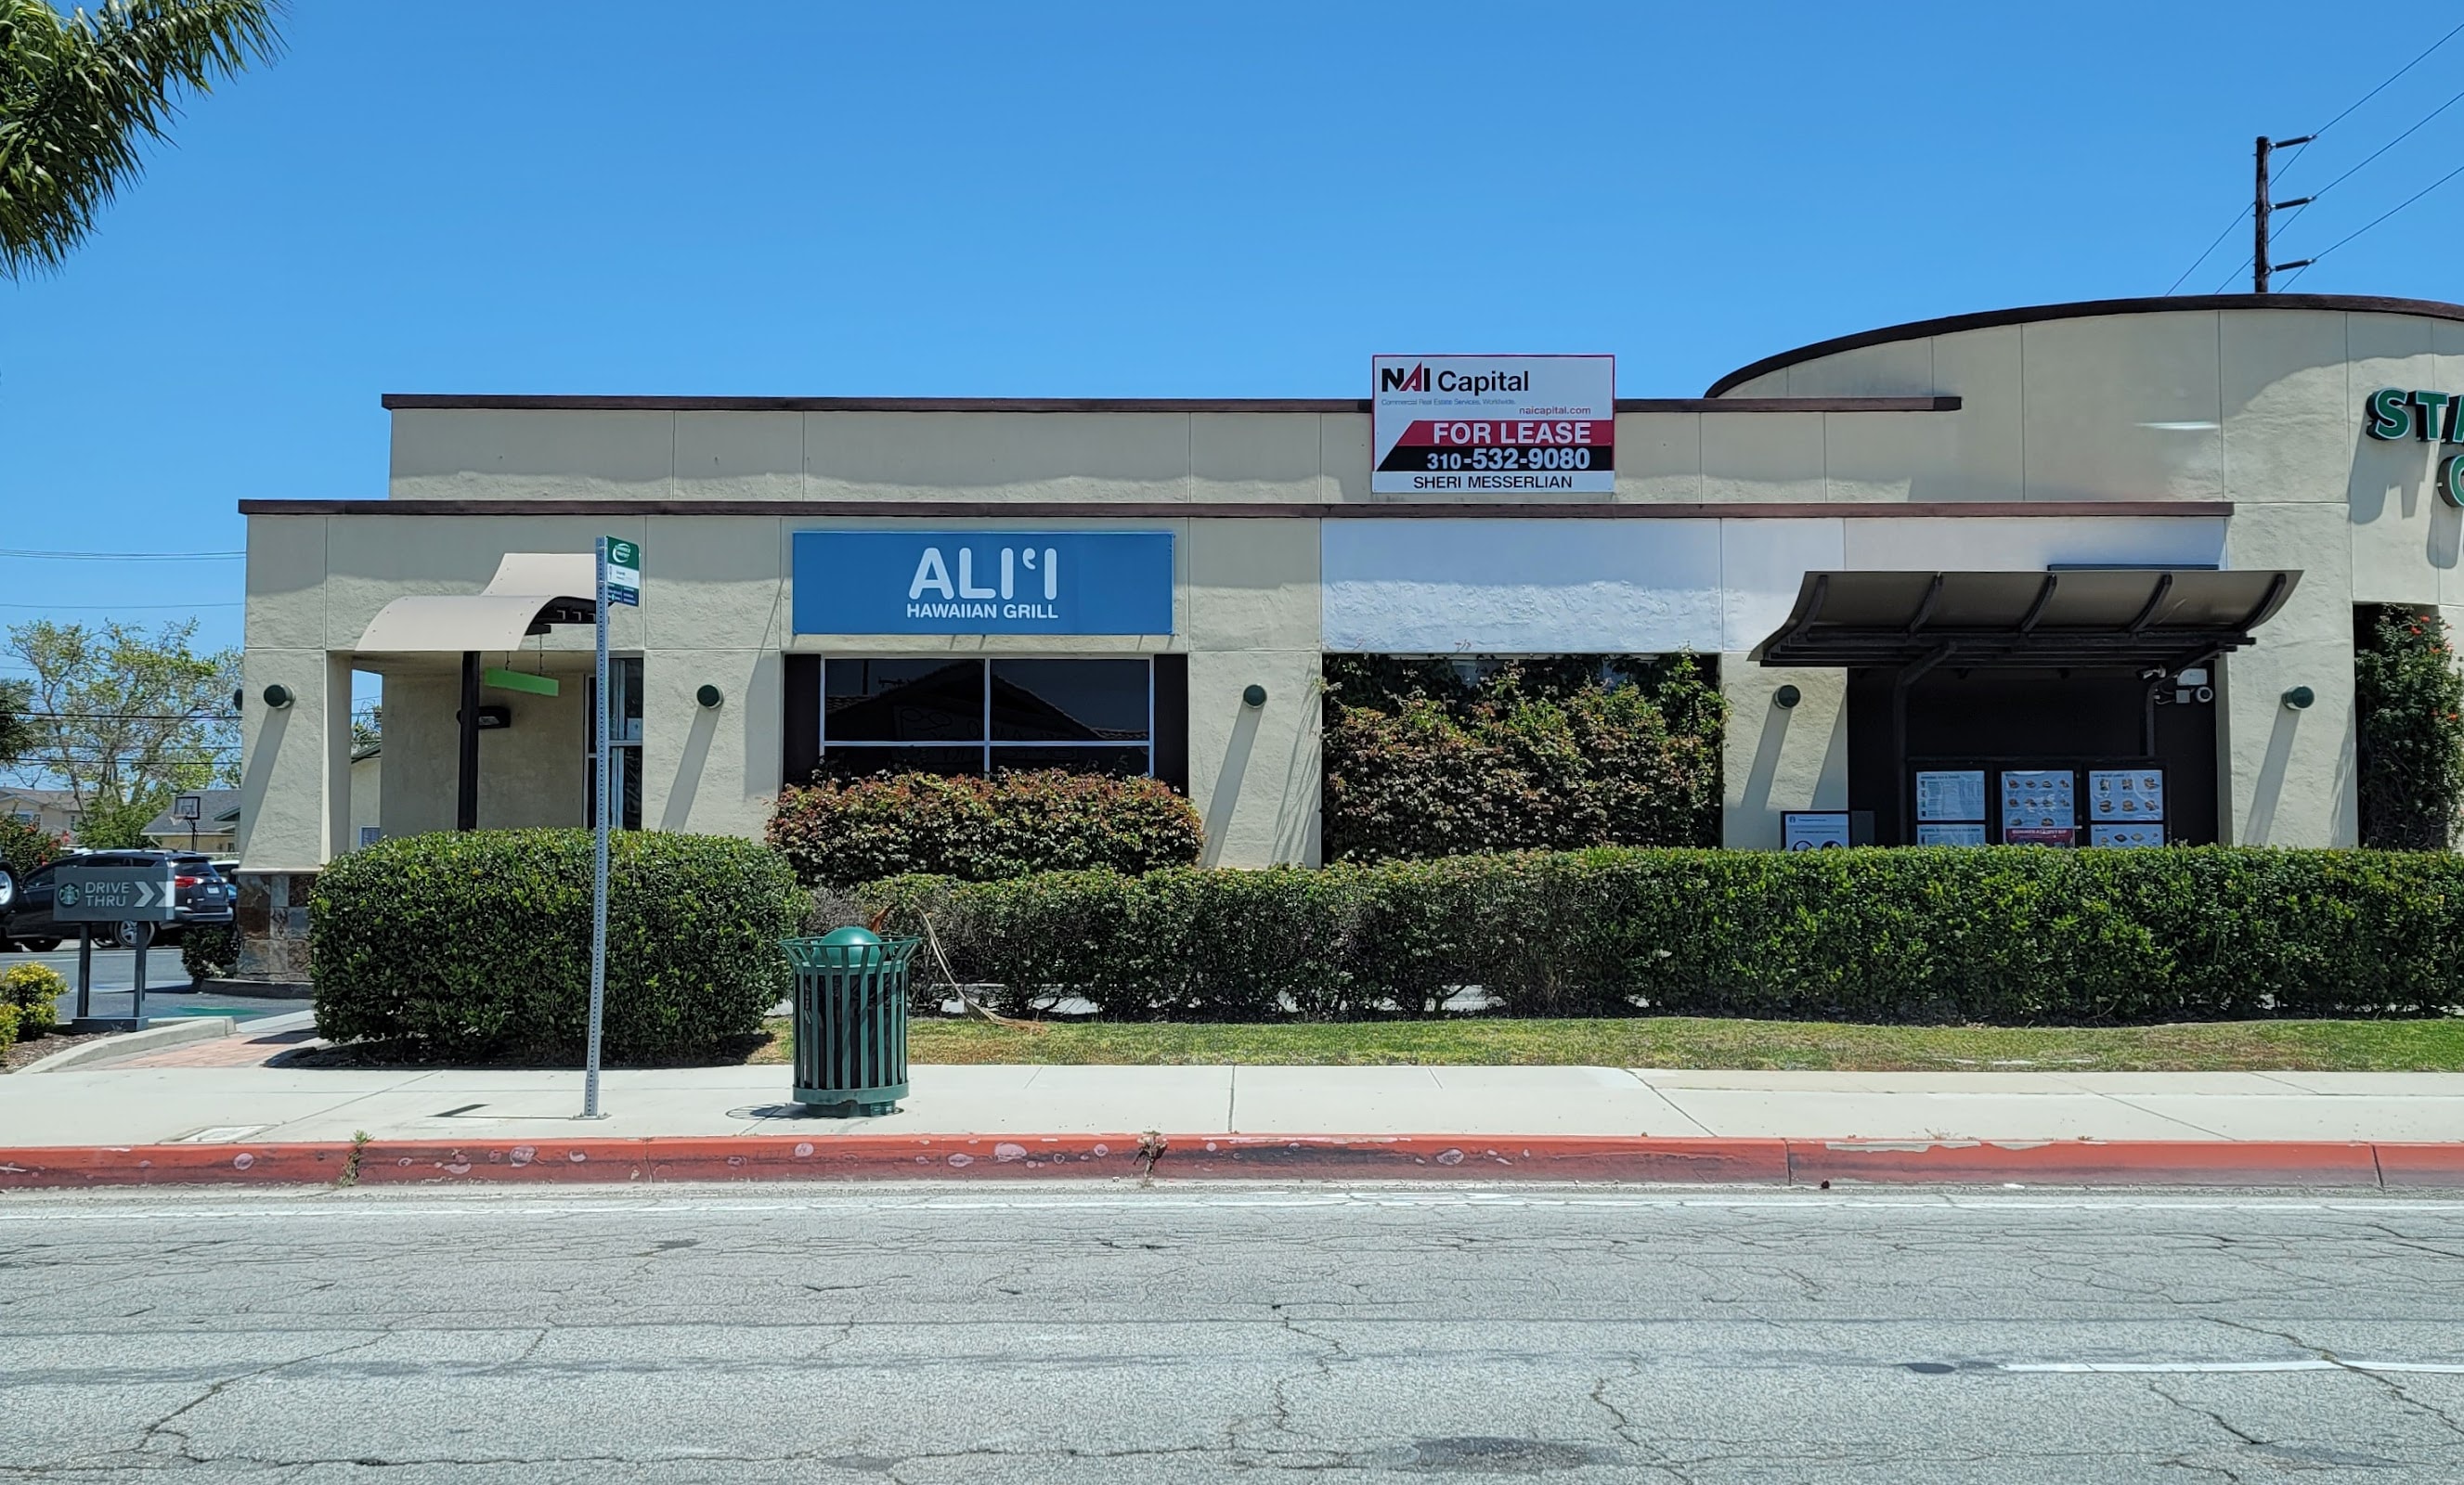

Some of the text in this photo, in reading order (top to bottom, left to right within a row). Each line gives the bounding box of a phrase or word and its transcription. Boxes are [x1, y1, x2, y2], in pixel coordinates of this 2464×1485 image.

[1381, 361, 1529, 396] NAI Capital
[1519, 406, 1591, 416] naicapital.com
[1433, 422, 1591, 444] FOR LEASE
[1427, 447, 1590, 470] 310-532-9080
[1413, 475, 1572, 489] SHERI MESSERLIAN
[906, 603, 1059, 619] HAWAIIAN GRILL
[84, 882, 130, 894] DRIVE
[84, 895, 126, 907] THRU
